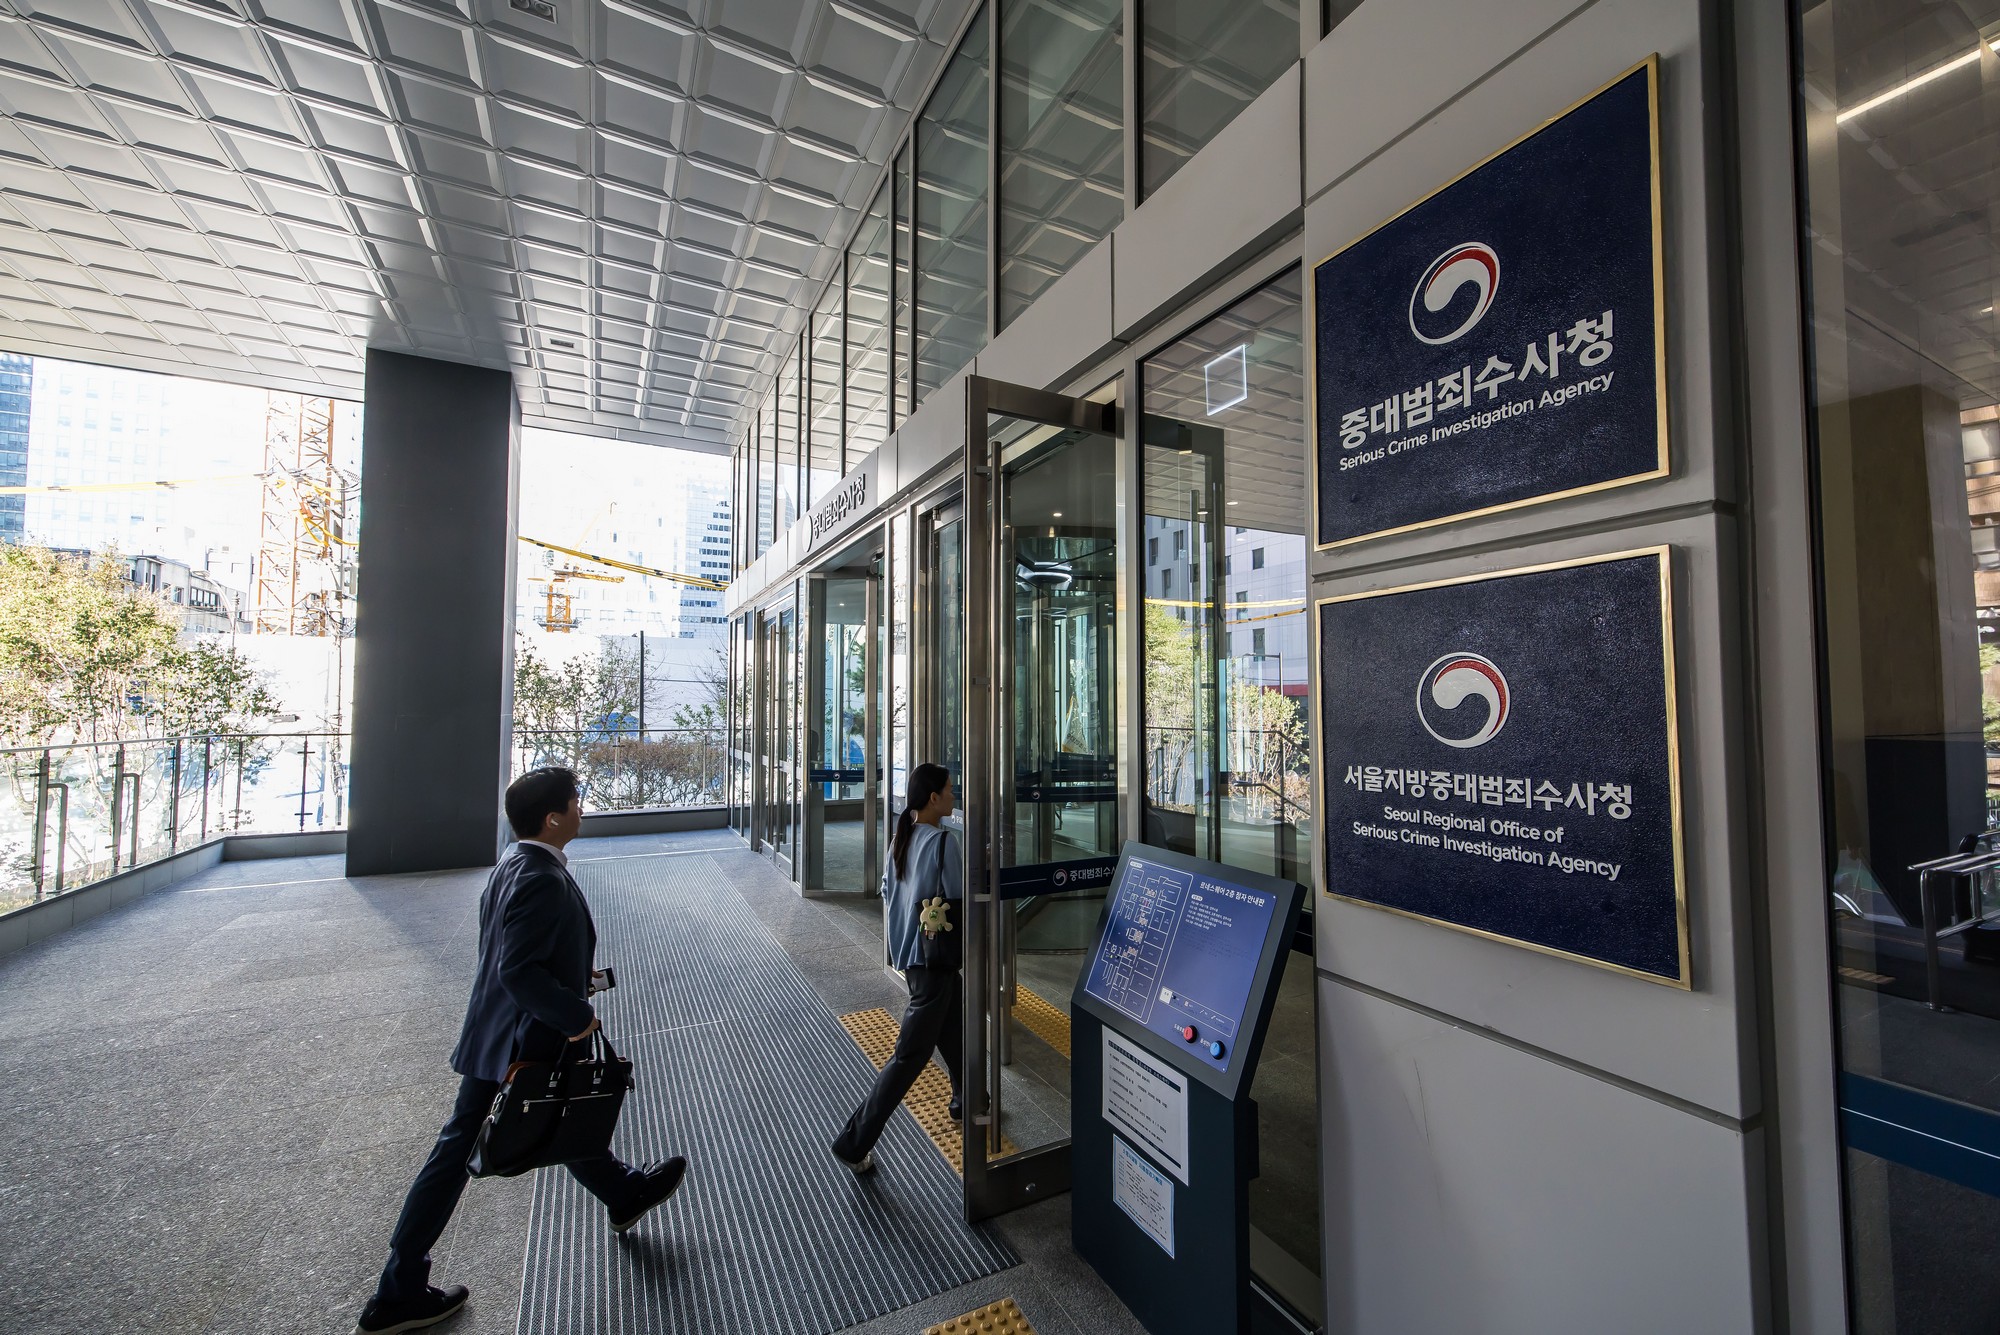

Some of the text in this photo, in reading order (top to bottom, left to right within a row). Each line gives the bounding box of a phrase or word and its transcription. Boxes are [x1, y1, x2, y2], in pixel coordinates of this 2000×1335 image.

[1339, 310, 1614, 449] 중대범죄수사청
[1339, 371, 1615, 471] Serious Crime Investigation Agency
[812, 473, 866, 540] 중대범죄수사청
[1344, 765, 1633, 819] 서울지방중대범죄수사청
[1353, 821, 1622, 881] Serious Crime Investigation Agency
[1384, 806, 1565, 844] Seoul Regional Office of
